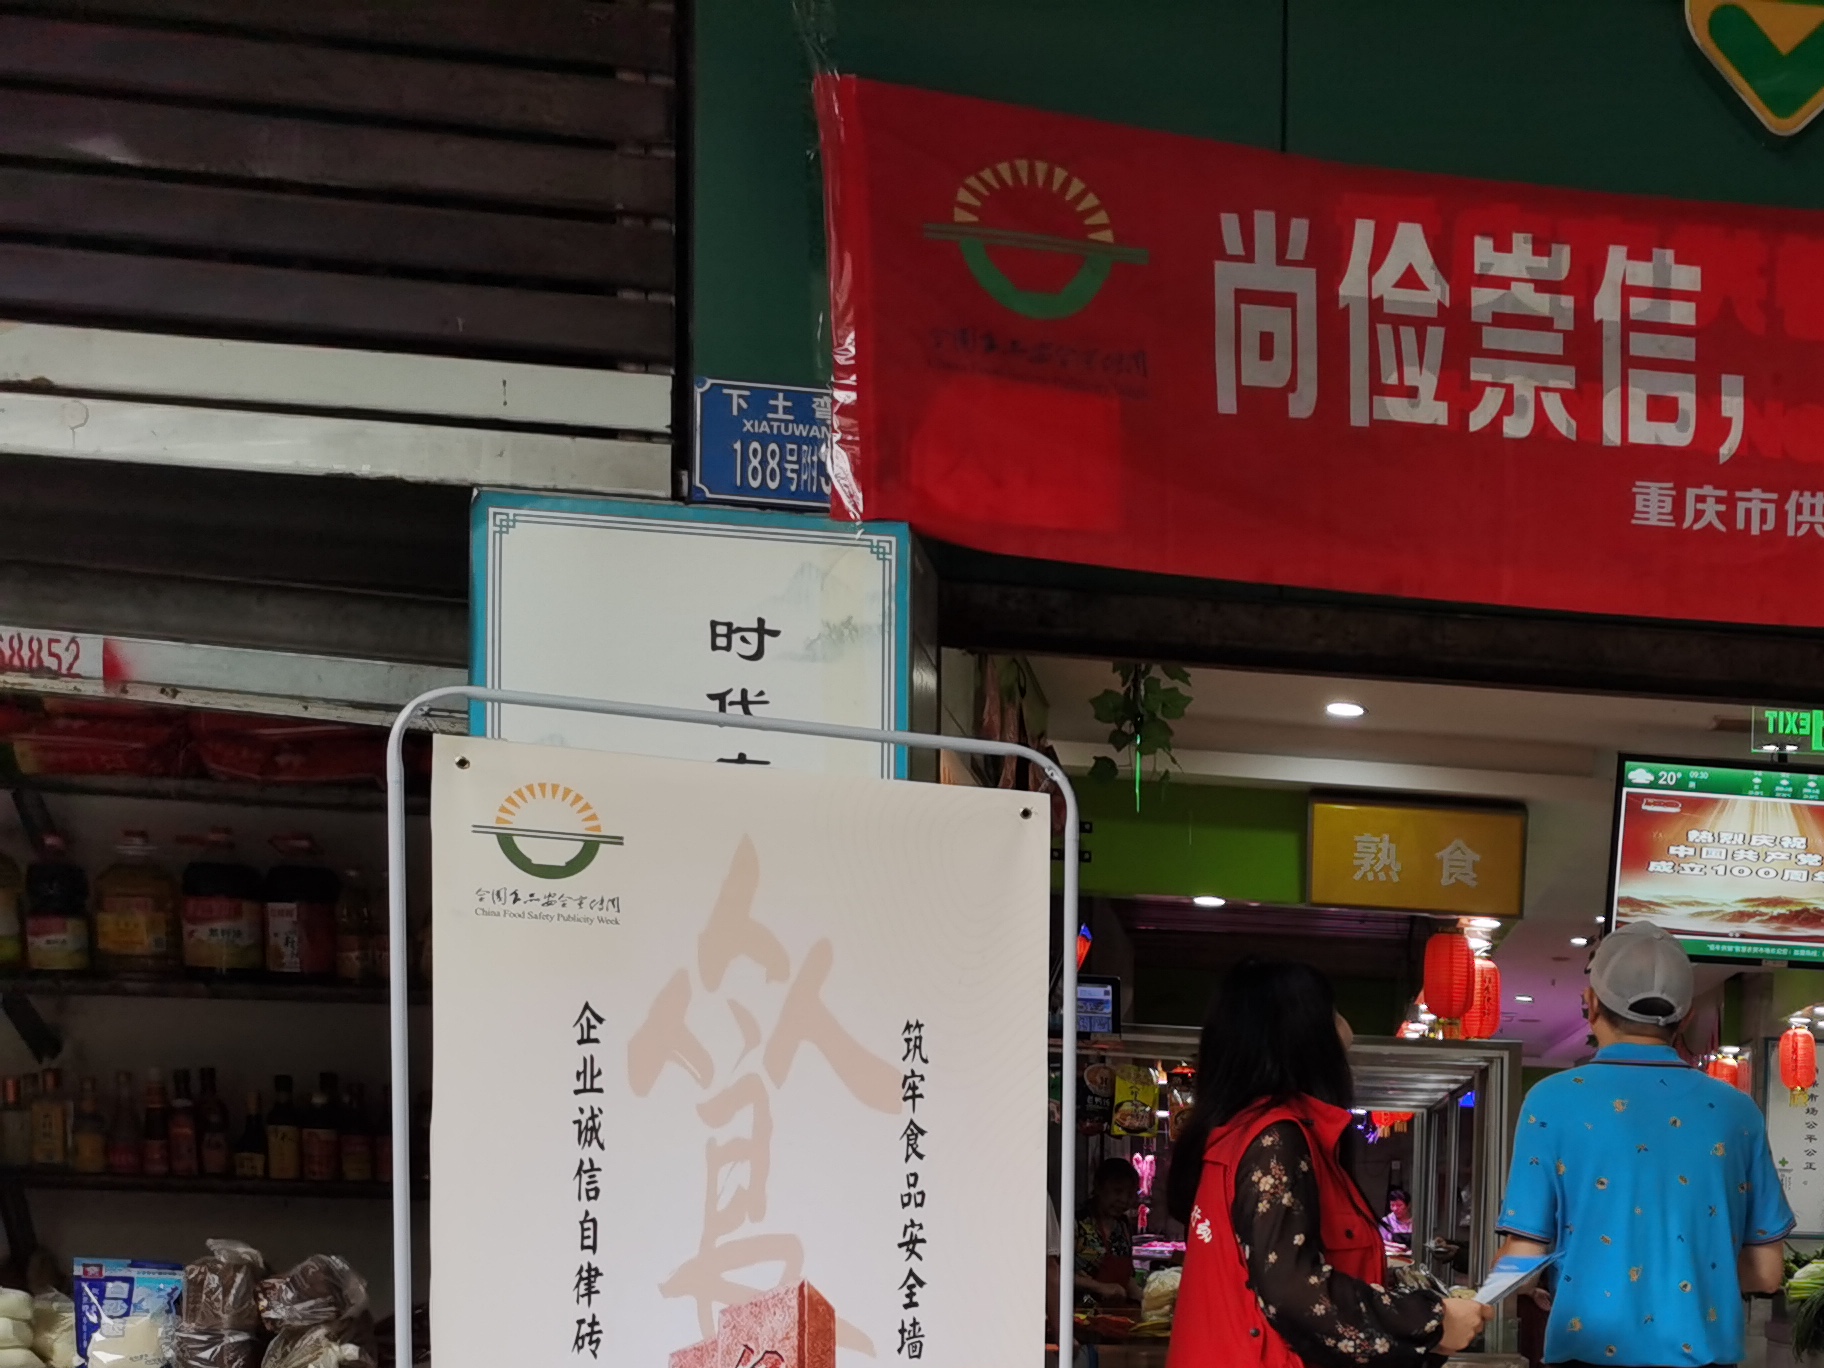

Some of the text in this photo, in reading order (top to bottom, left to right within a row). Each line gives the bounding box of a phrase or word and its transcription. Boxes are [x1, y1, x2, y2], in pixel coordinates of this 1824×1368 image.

[0, 632, 83, 678] 8852
[1352, 831, 1482, 888] 熟食
[1667, 844, 1824, 868] 中国共产党
[1686, 828, 1809, 850] 热烈庆祝
[474, 906, 621, 926] China Food Safety Publicity Week
[571, 999, 606, 1361] 企业诚信自律砖
[895, 1017, 930, 1361] 筑牢食品安全墙
